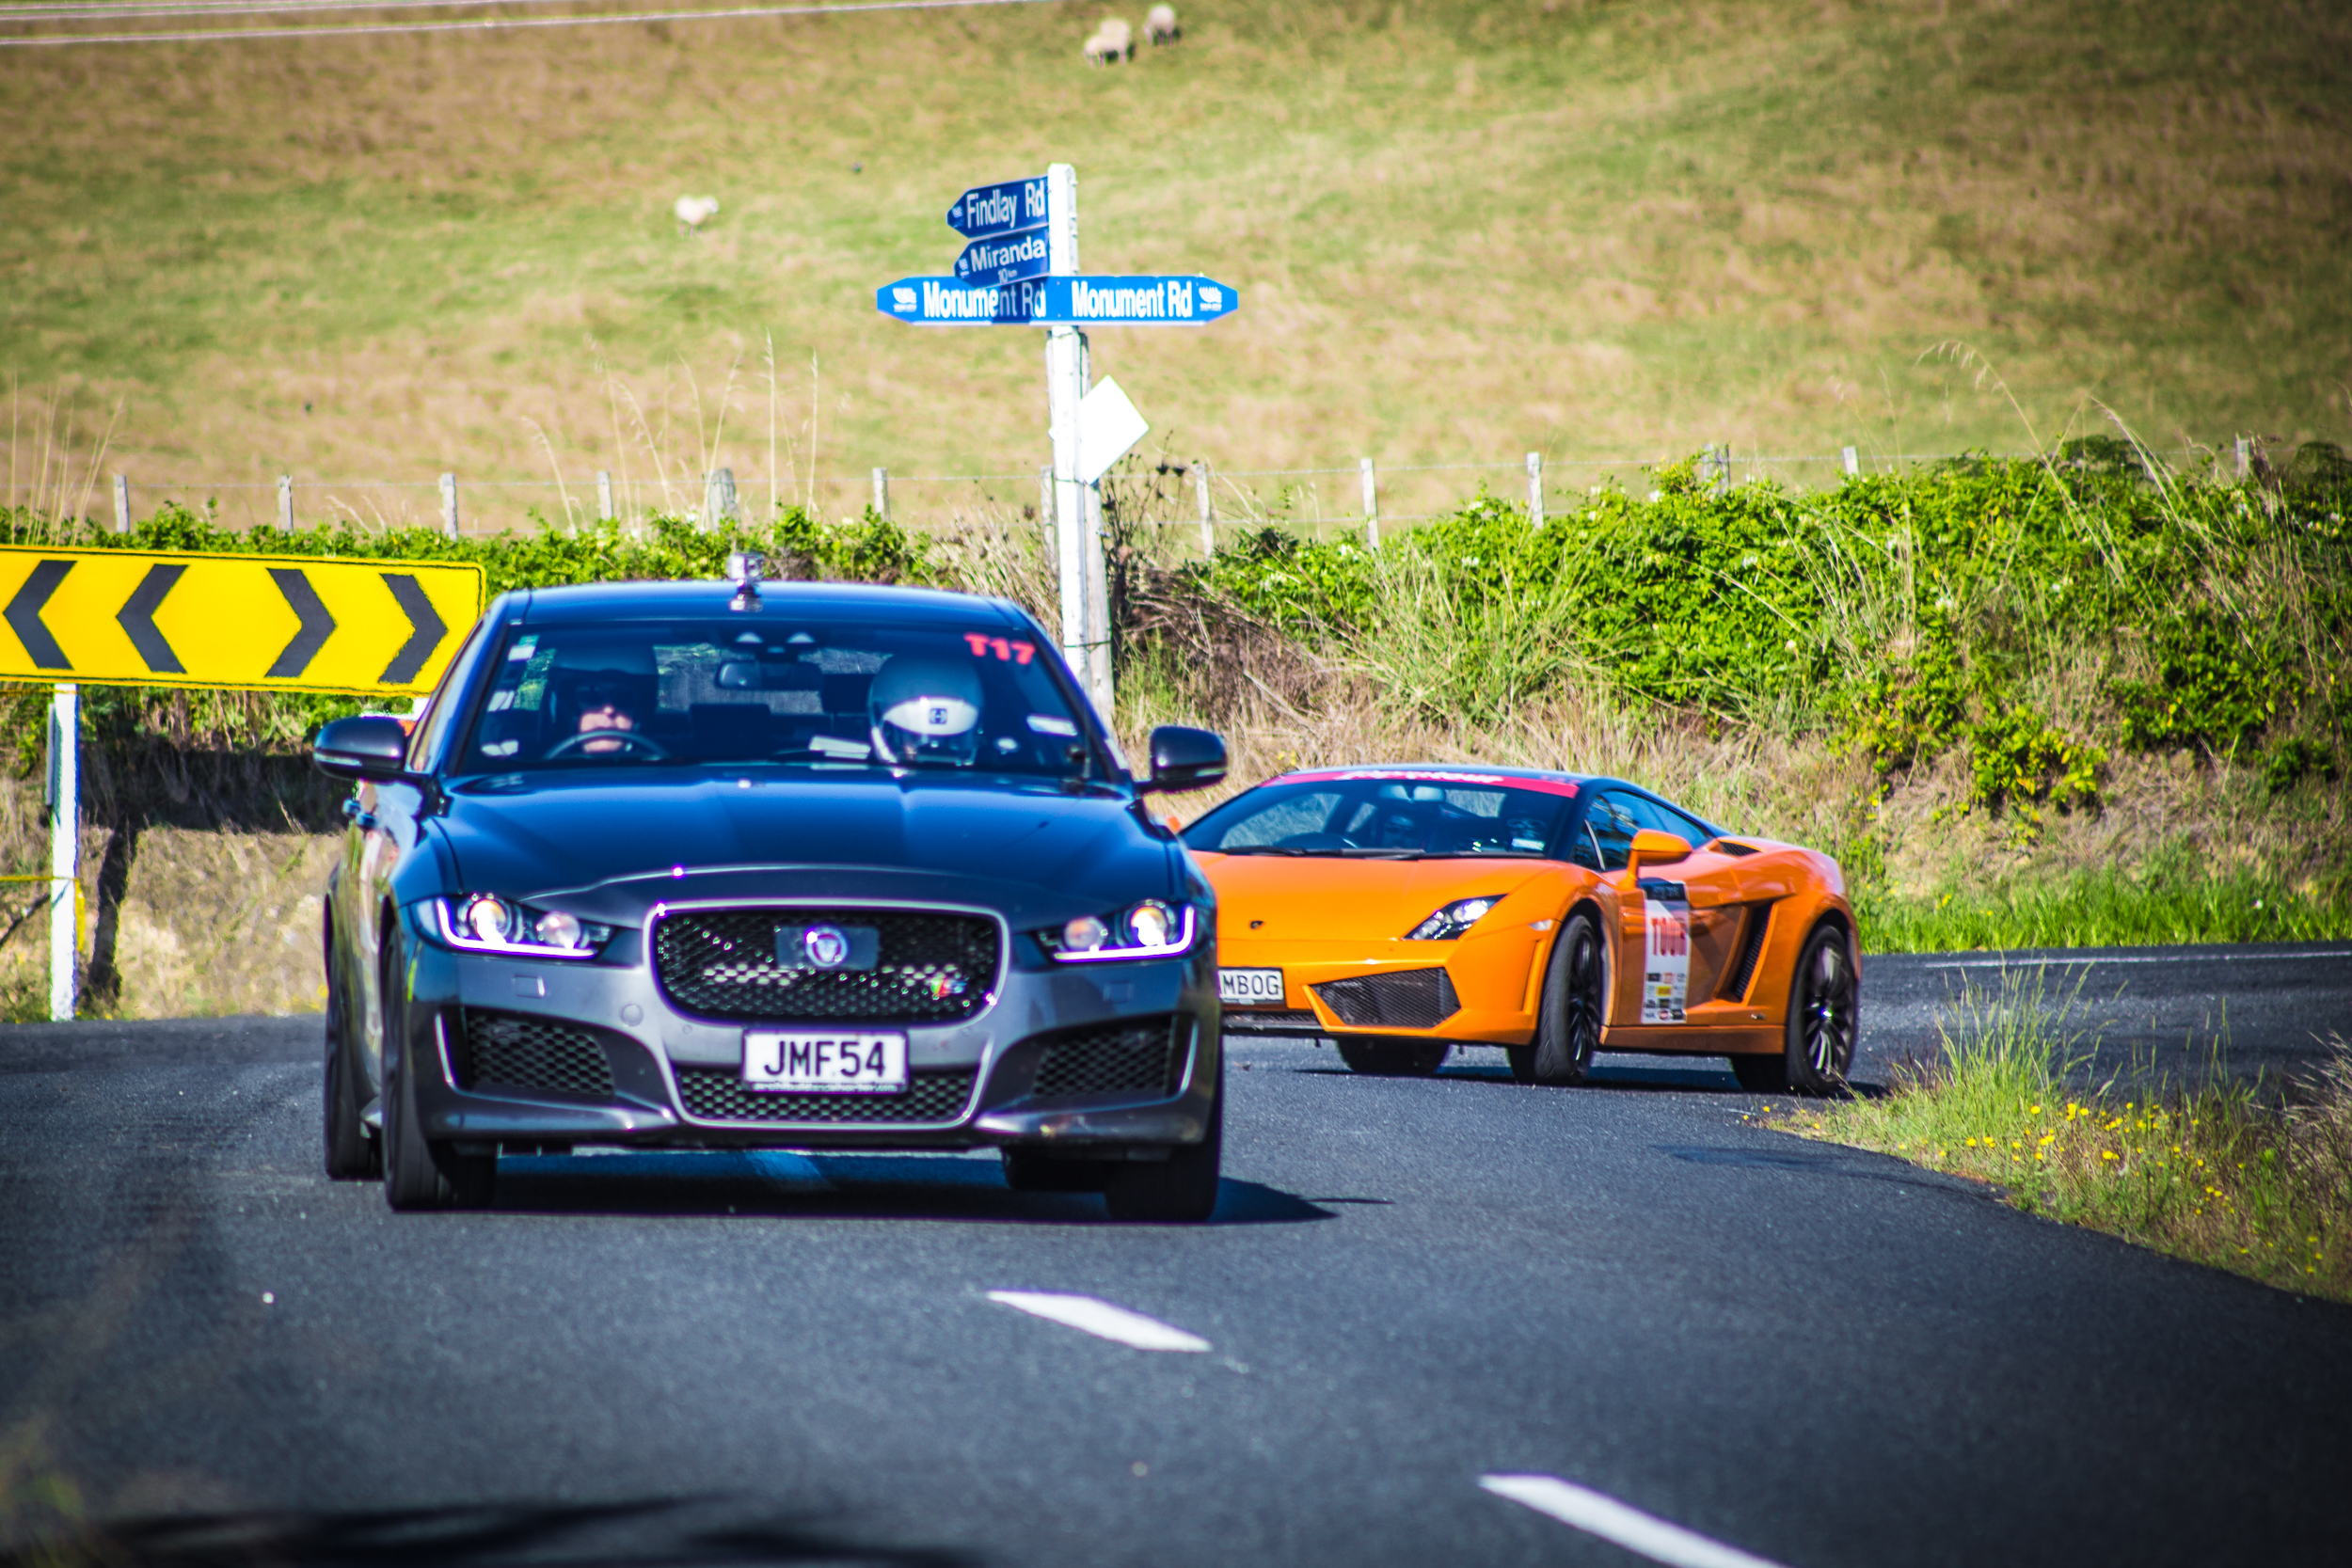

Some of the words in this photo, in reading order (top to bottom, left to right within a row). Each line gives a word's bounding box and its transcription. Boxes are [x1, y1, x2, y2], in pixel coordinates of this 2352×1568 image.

[966, 189, 1017, 229] Findlay
[1025, 179, 1046, 218] Rd
[971, 235, 1046, 271] Miranda
[997, 268, 1009, 284] 10
[923, 281, 1017, 318] Monument
[1022, 282, 1046, 318] Rd
[1072, 280, 1164, 318] Monument
[1168, 279, 1193, 317] Rd
[963, 633, 1036, 665] T17
[1218, 974, 1279, 995] MBOG
[763, 1040, 885, 1078] JMF54
